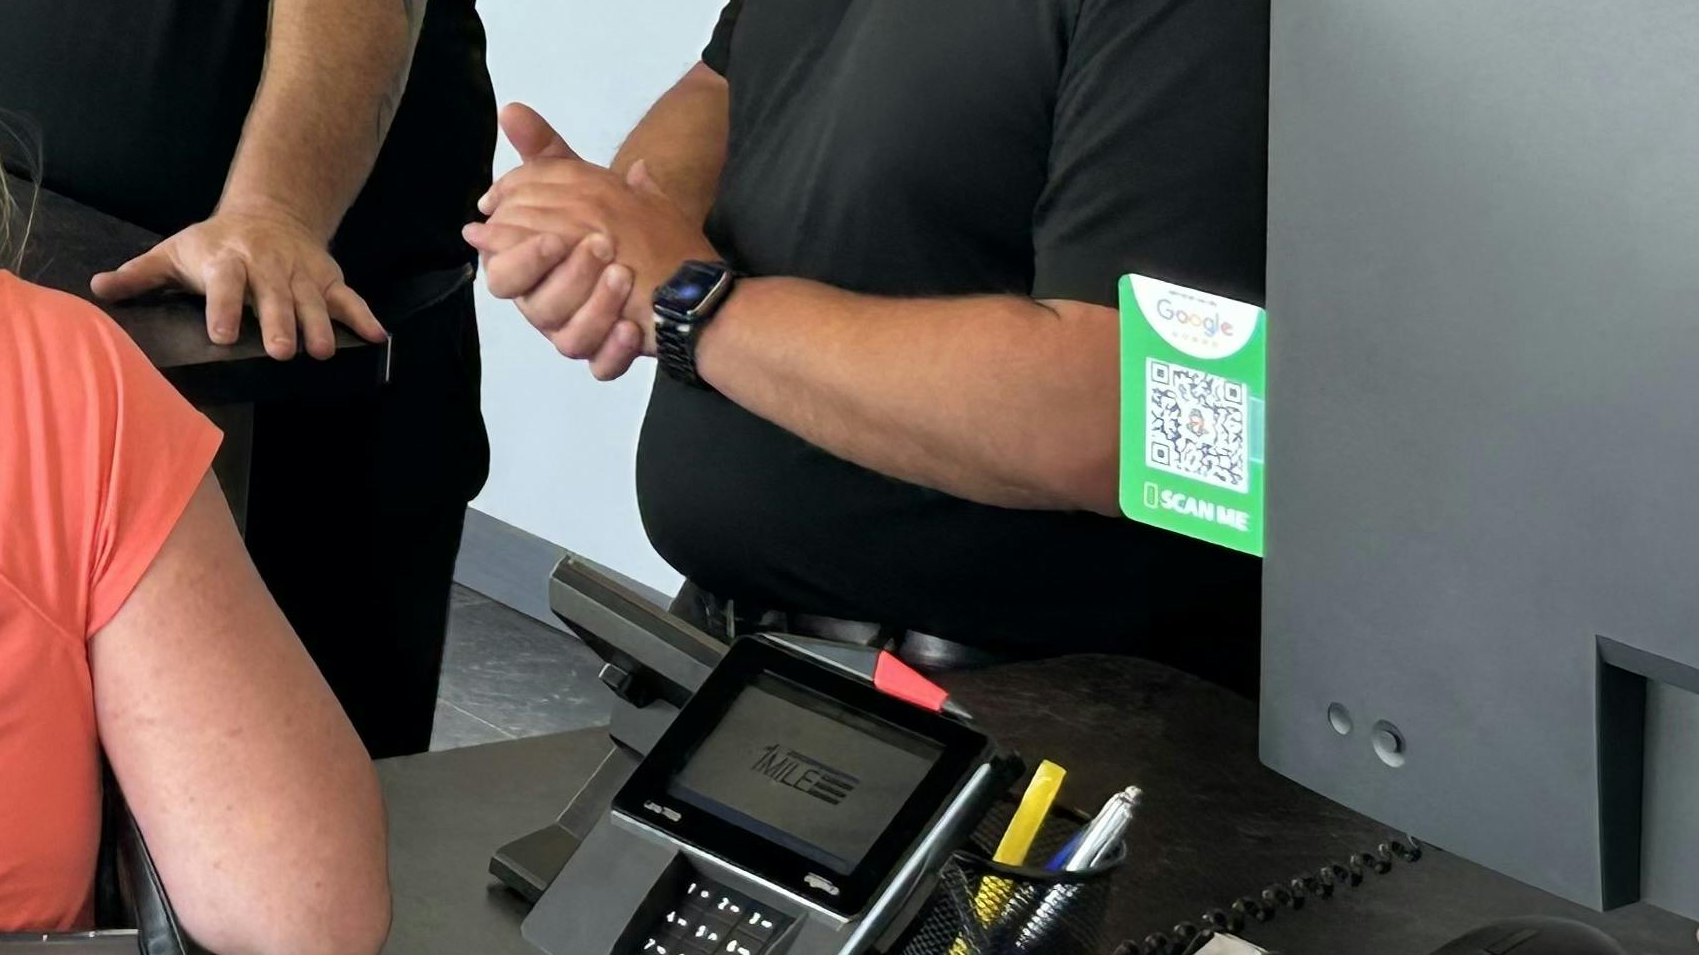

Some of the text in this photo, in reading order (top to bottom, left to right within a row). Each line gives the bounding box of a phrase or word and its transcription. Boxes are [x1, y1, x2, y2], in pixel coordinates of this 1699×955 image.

[1156, 297, 1234, 338] Google
[1160, 488, 1250, 533] SCAN ME
